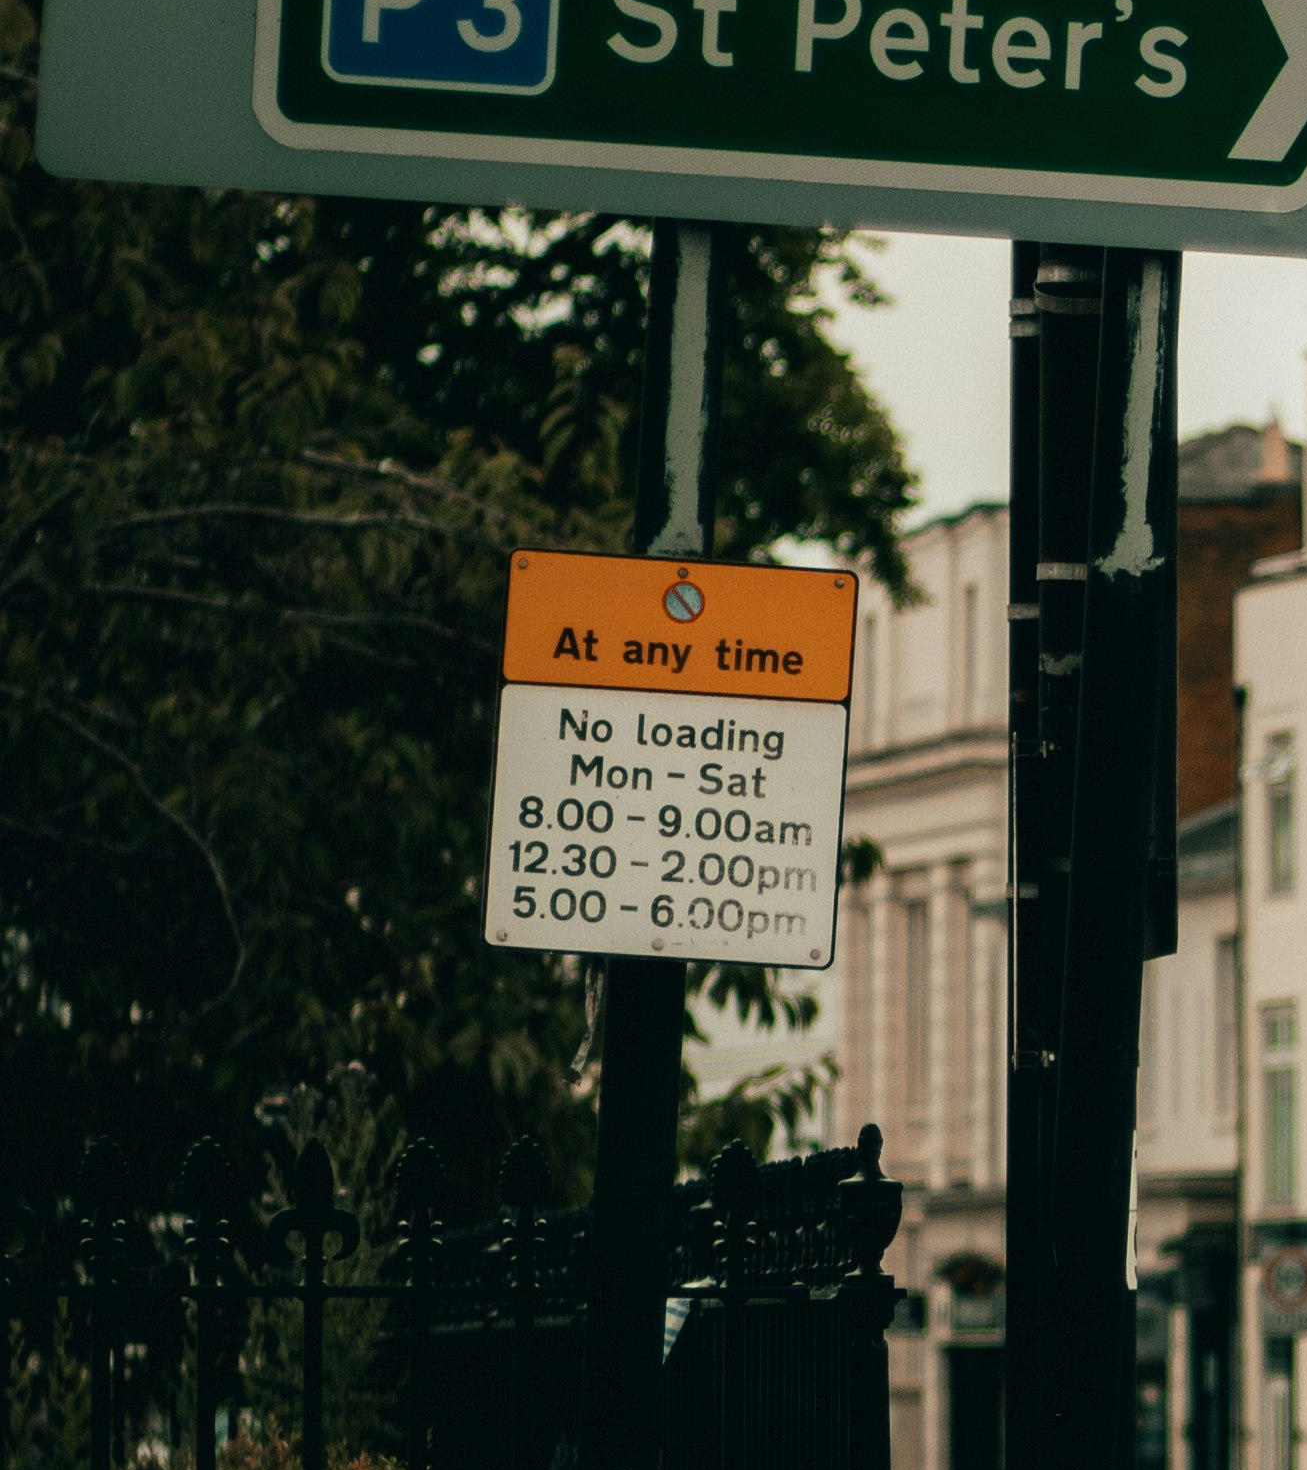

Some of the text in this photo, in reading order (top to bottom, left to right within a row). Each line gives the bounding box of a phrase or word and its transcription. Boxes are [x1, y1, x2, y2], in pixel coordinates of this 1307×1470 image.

[554, 627, 803, 674] At any time
[559, 709, 784, 760] No loading
[571, 754, 652, 790] Mon
[699, 763, 766, 797] Sat
[519, 796, 613, 833] 8.00
[659, 805, 810, 844] 9.00am
[509, 841, 616, 878] 12.30
[662, 850, 817, 894] 2.00pm
[513, 886, 606, 923] 5.00
[651, 895, 806, 938] 6.00pm
